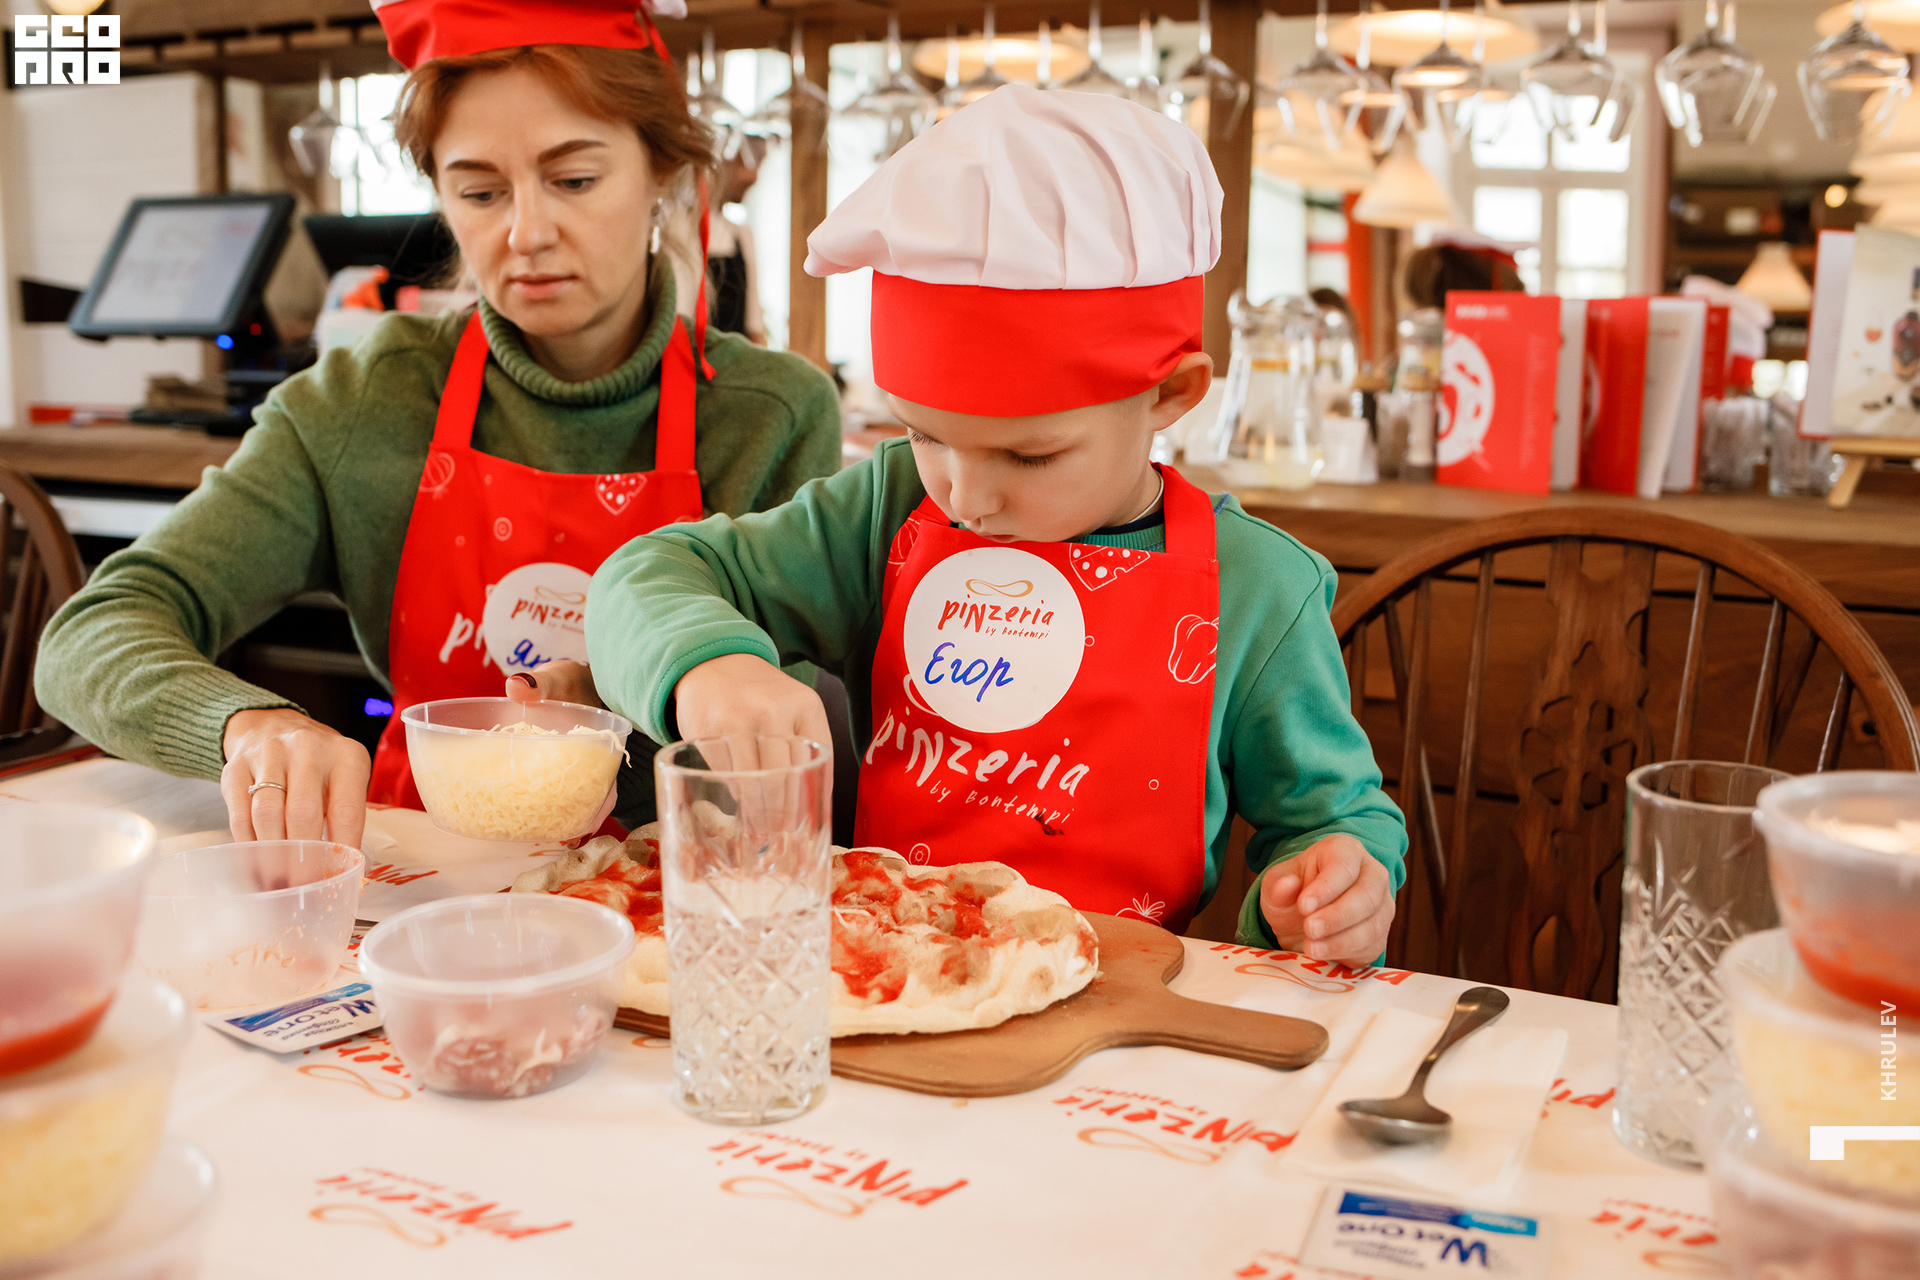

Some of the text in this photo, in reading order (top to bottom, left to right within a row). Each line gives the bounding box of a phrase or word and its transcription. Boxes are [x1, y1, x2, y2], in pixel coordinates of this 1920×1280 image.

[511, 598, 583, 624] piNzer
[985, 626, 997, 636] by
[924, 642, 1014, 702] Егор
[930, 780, 951, 803] by
